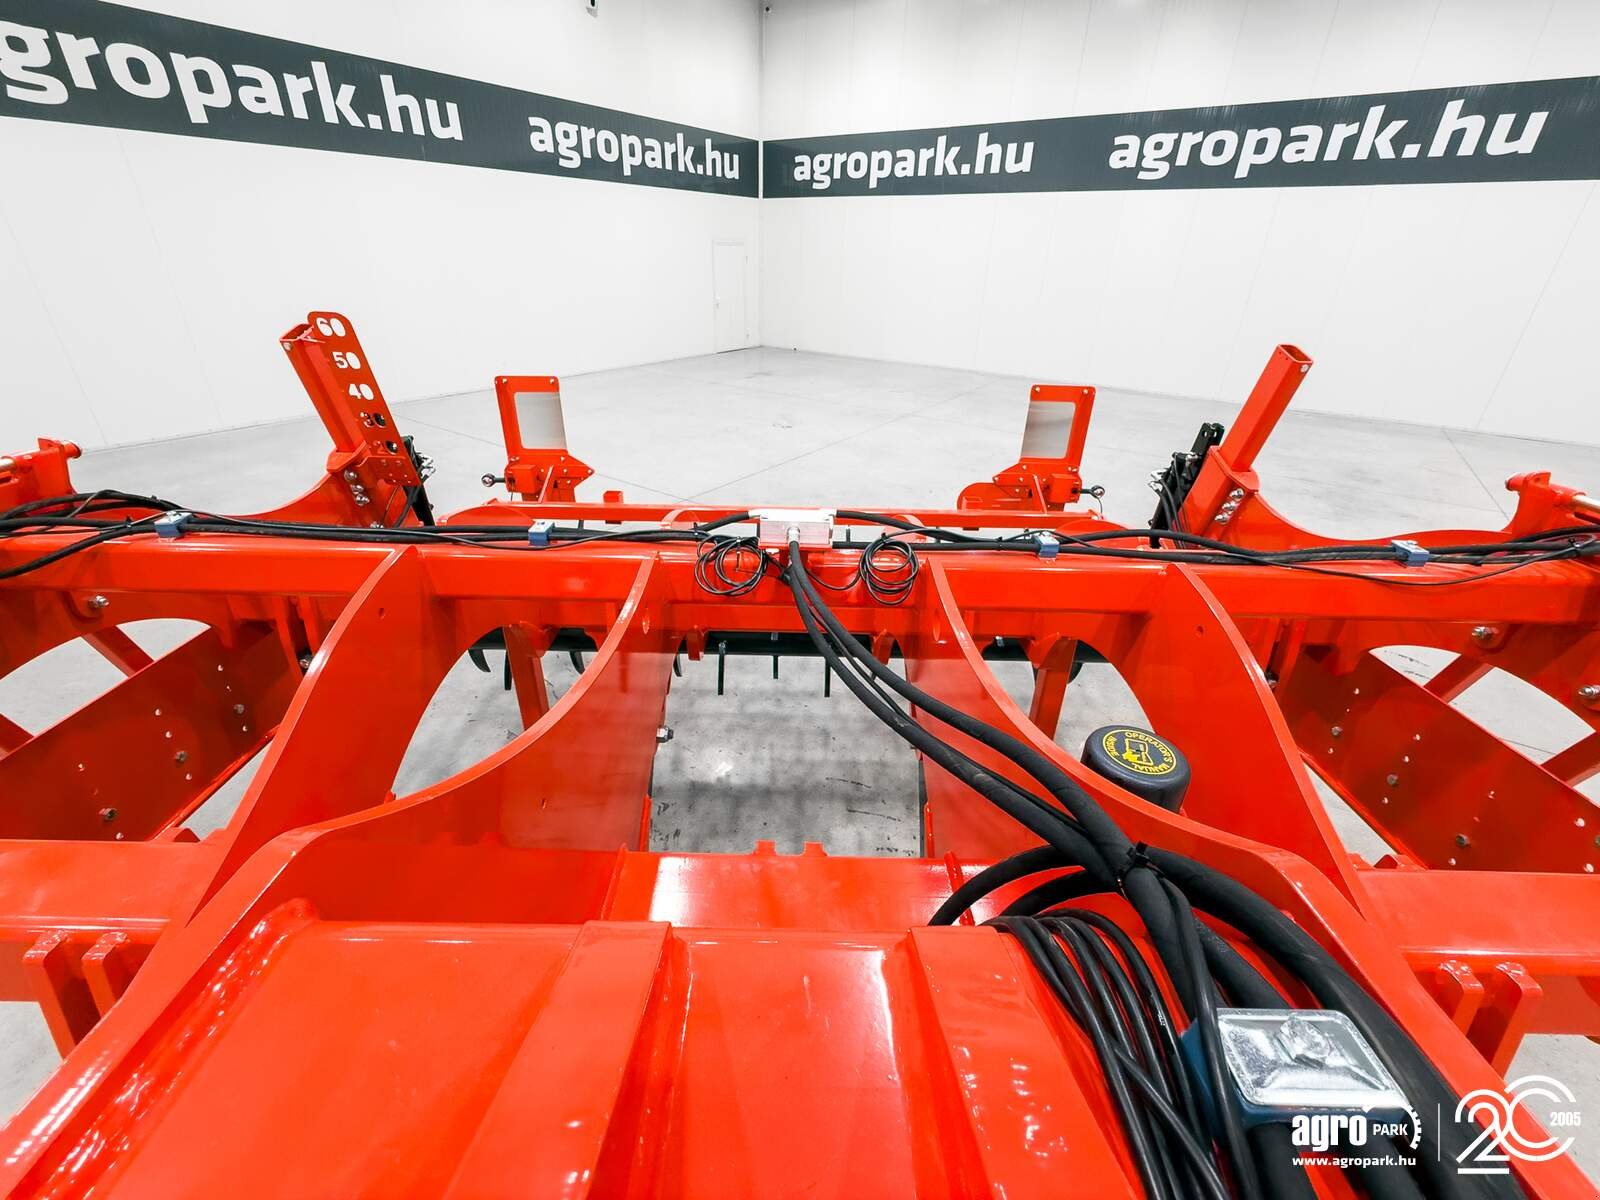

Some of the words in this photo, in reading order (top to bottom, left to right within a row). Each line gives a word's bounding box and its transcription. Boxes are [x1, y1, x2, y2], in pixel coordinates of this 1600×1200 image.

[528, 116, 740, 182] agropark.hu
[1108, 98, 1549, 181] agropark.hu
[793, 131, 1035, 190] agropark.hu
[316, 317, 346, 337] 60
[332, 351, 361, 369] 50
[349, 383, 374, 400] 40
[360, 411, 386, 428] 30
